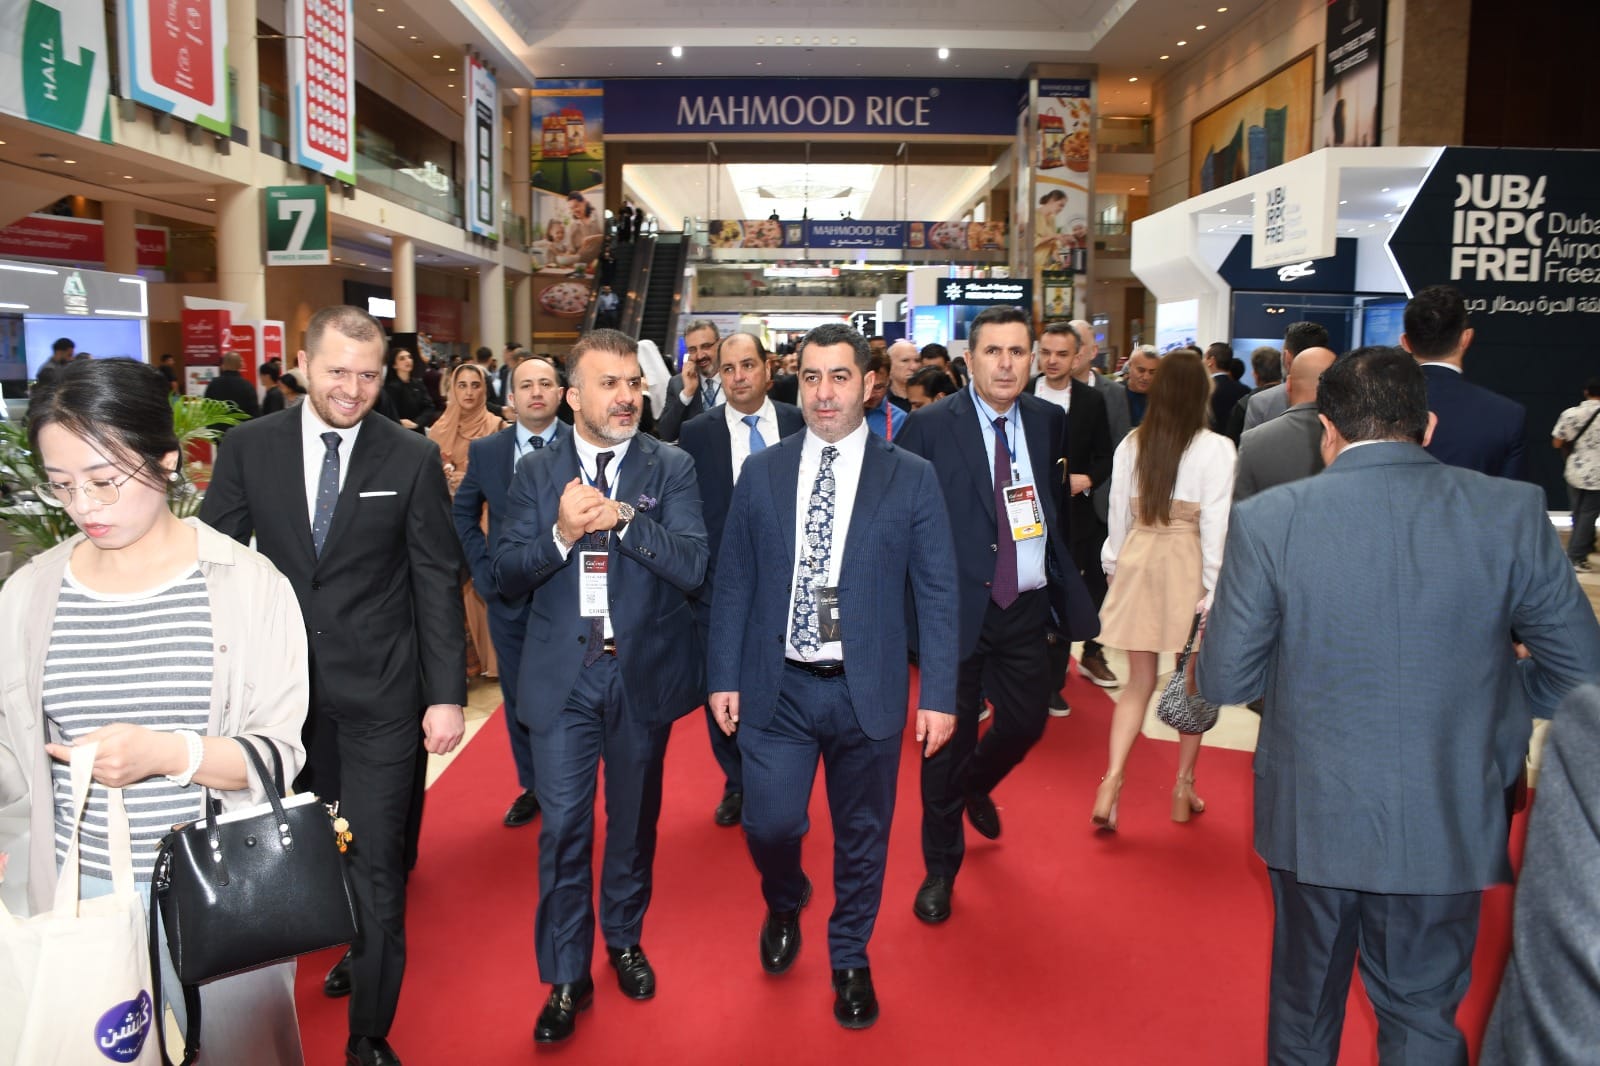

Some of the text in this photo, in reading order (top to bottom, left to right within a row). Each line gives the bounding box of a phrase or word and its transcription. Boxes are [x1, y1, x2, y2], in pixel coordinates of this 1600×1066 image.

[40, 38, 58, 101] HALL
[676, 95, 931, 126] MAHMOOD RICE
[278, 199, 317, 251] 7
[813, 226, 898, 236] MAHMOOD RICE
